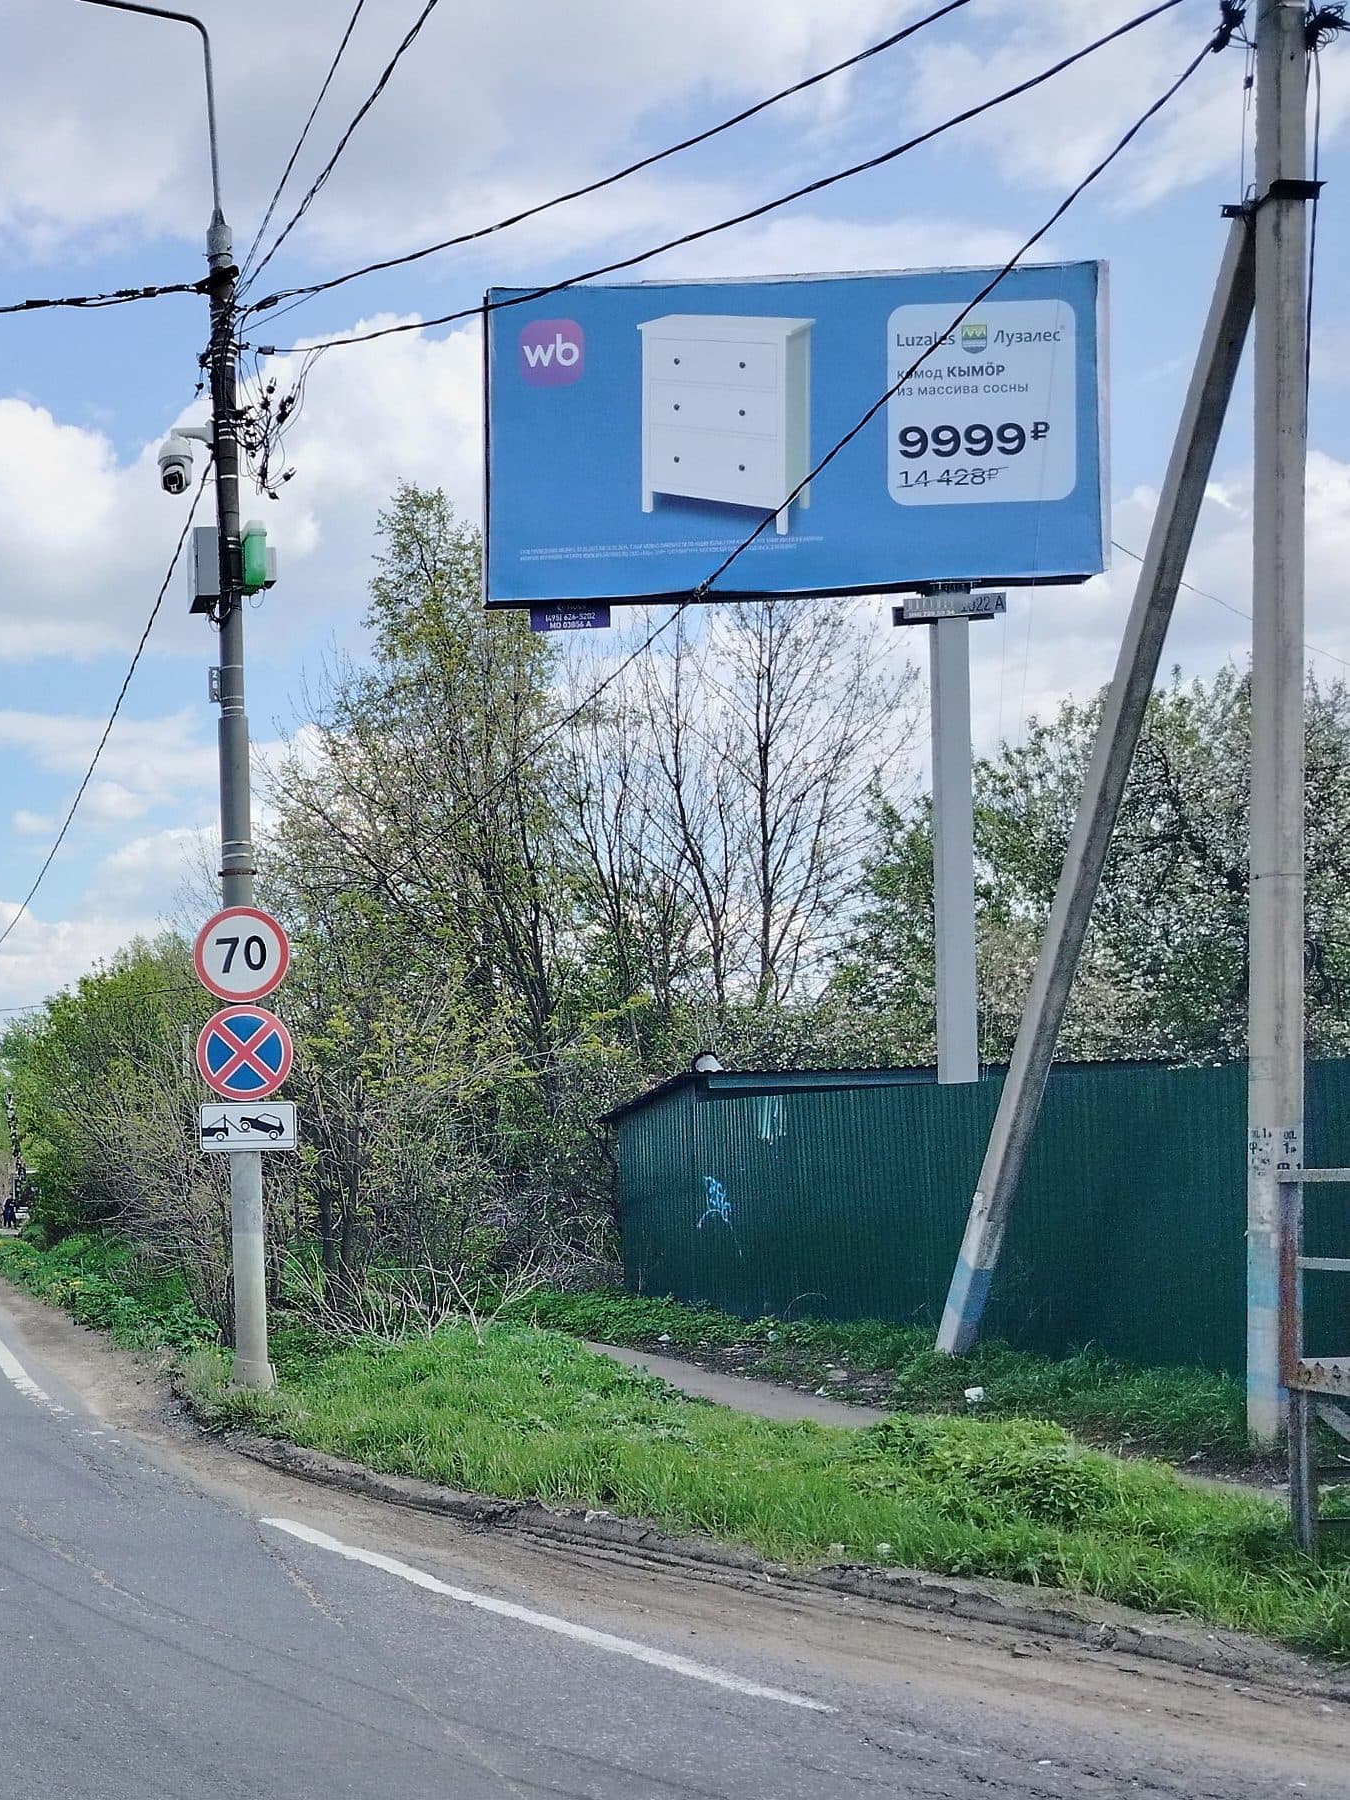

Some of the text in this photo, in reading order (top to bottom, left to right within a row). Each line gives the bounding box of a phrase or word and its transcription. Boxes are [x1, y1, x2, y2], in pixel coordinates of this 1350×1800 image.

[522, 333, 579, 368] wb
[993, 329, 1061, 347] Лузалес
[897, 382, 1029, 397] из массива сосны
[215, 934, 268, 975] 70
